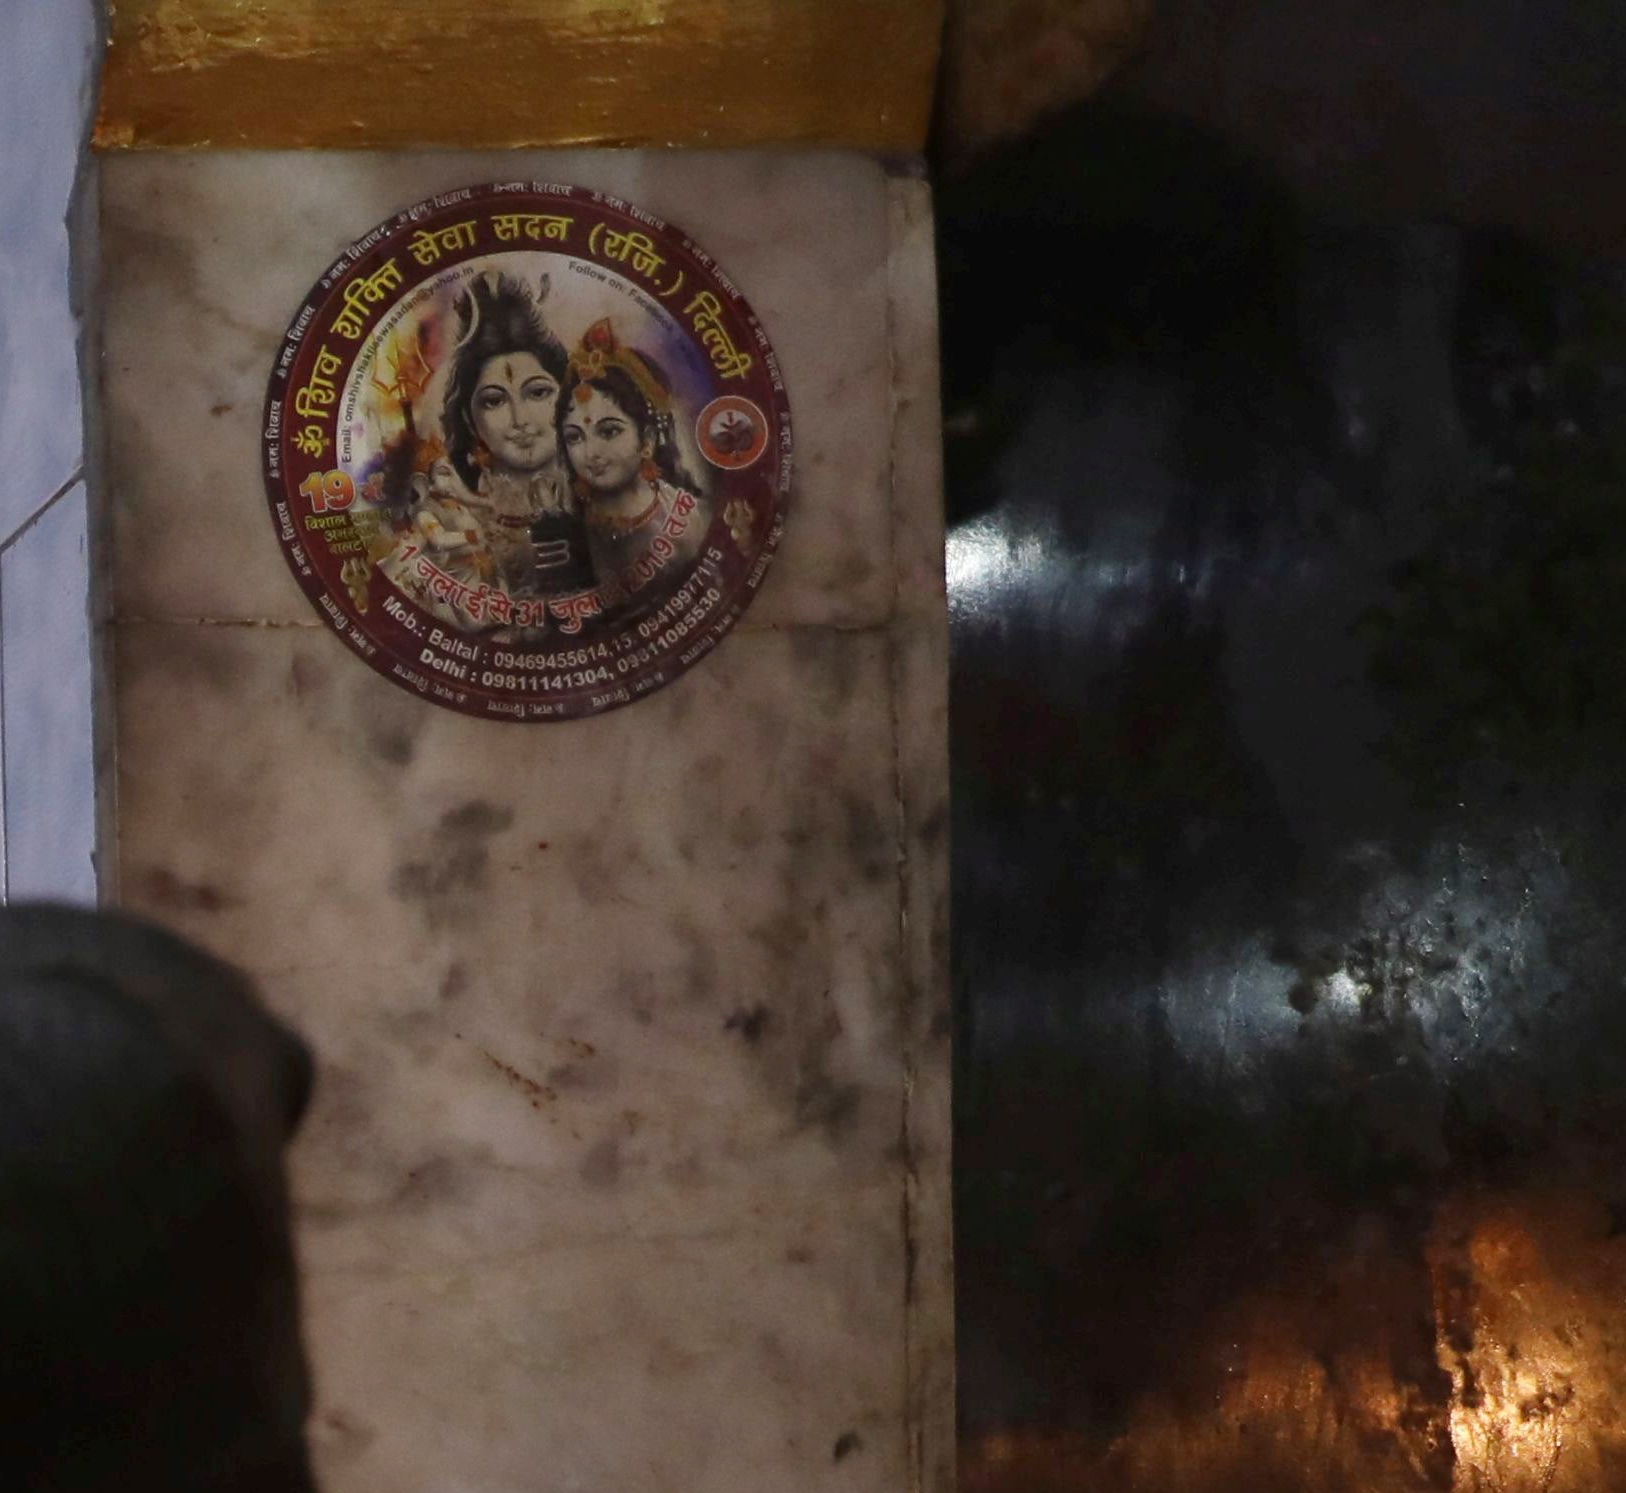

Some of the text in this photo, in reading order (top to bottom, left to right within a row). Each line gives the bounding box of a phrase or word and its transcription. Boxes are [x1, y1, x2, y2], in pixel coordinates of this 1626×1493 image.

[569, 262, 611, 282] Follow
[296, 214, 751, 455] ॐ शिव शक्ति सेवा सदन (रजि.) दिल्ली
[299, 470, 355, 513] 19
[429, 629, 478, 660] Baltal
[420, 649, 466, 678] Delhi
